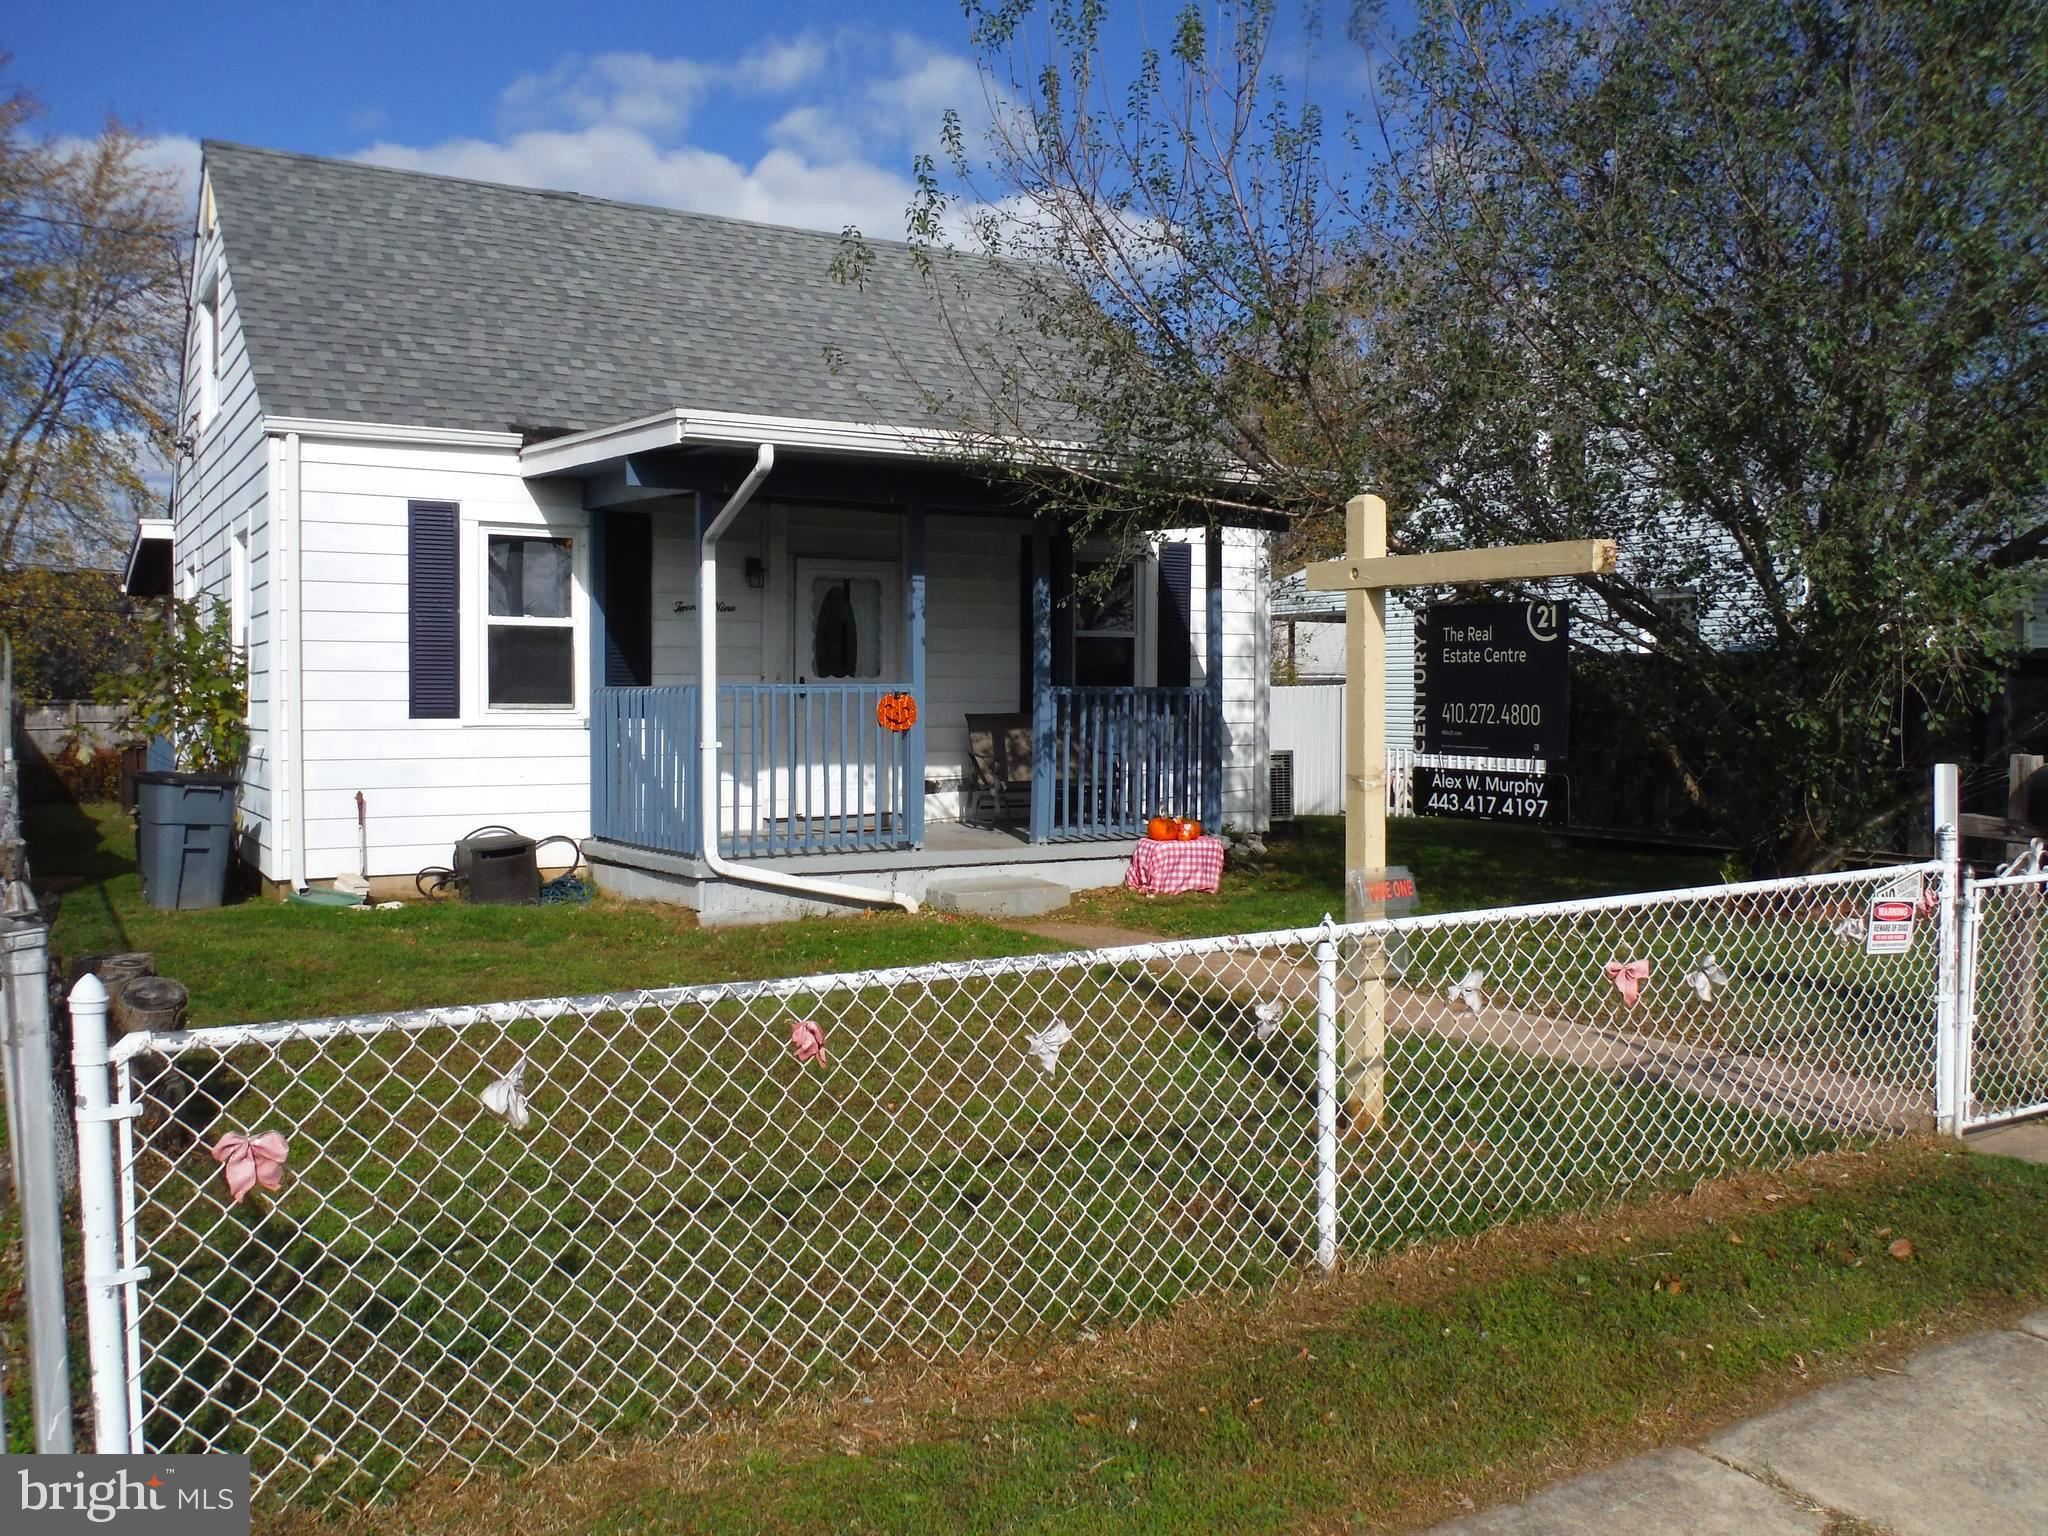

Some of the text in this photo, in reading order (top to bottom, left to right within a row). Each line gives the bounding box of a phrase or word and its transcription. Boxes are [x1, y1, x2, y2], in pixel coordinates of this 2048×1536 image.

[1442, 626, 1493, 643] The Real
[1443, 647, 1527, 663] Estate Centre
[1413, 633, 1428, 755] CENTURY
[1442, 703, 1541, 726] 410.272.4800
[1432, 773, 1544, 798] Alex W. Murphy
[1428, 793, 1548, 818] 443.417.4197
[1393, 879, 1414, 898] ONE
[1877, 907, 1908, 917] WARNING
